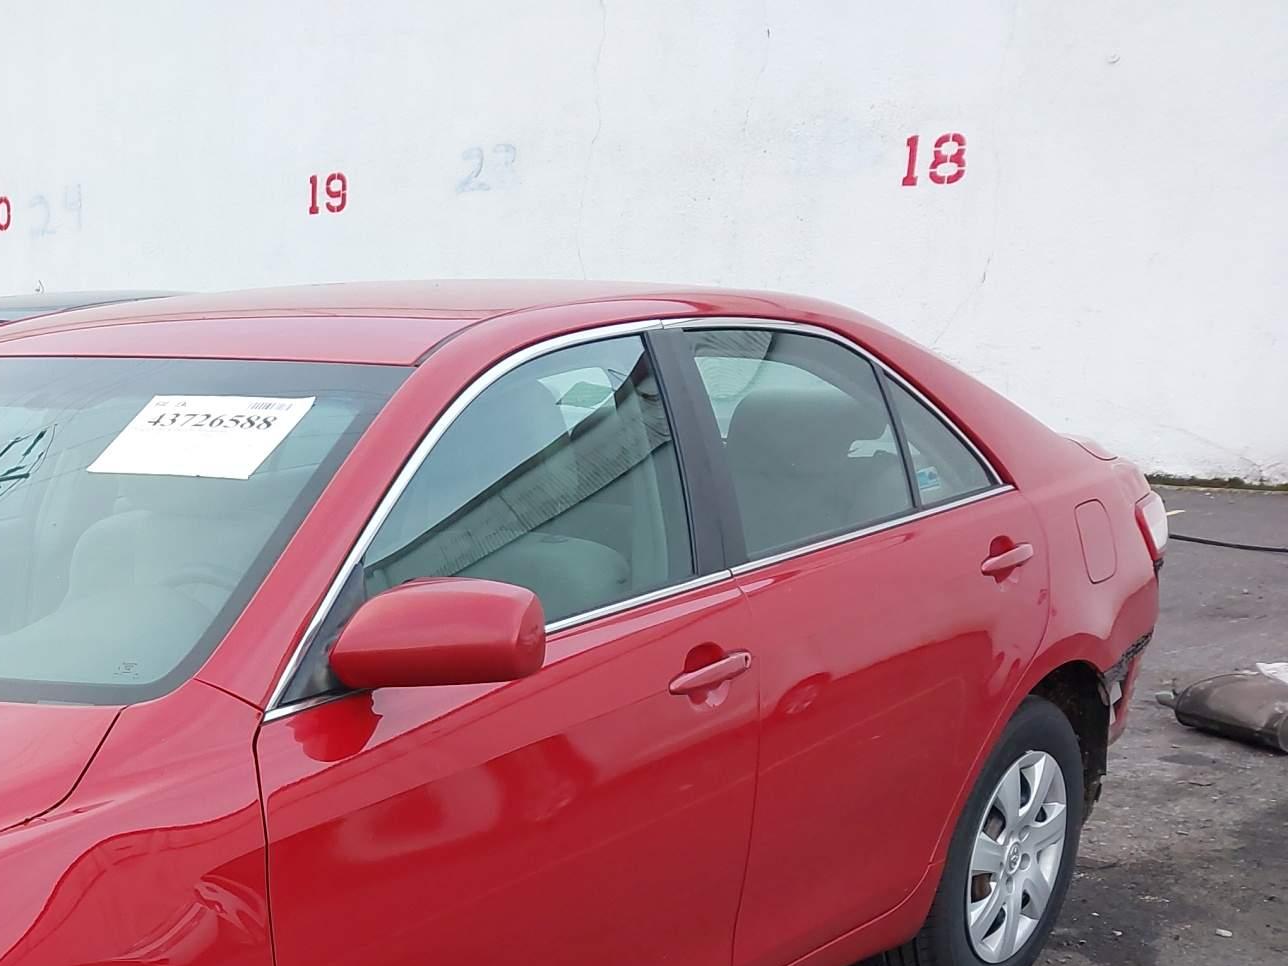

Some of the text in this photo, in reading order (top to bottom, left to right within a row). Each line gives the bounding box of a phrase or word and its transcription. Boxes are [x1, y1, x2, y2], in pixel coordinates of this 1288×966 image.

[901, 132, 968, 188] 18
[308, 172, 349, 216] 19
[147, 412, 277, 430] 43726588
